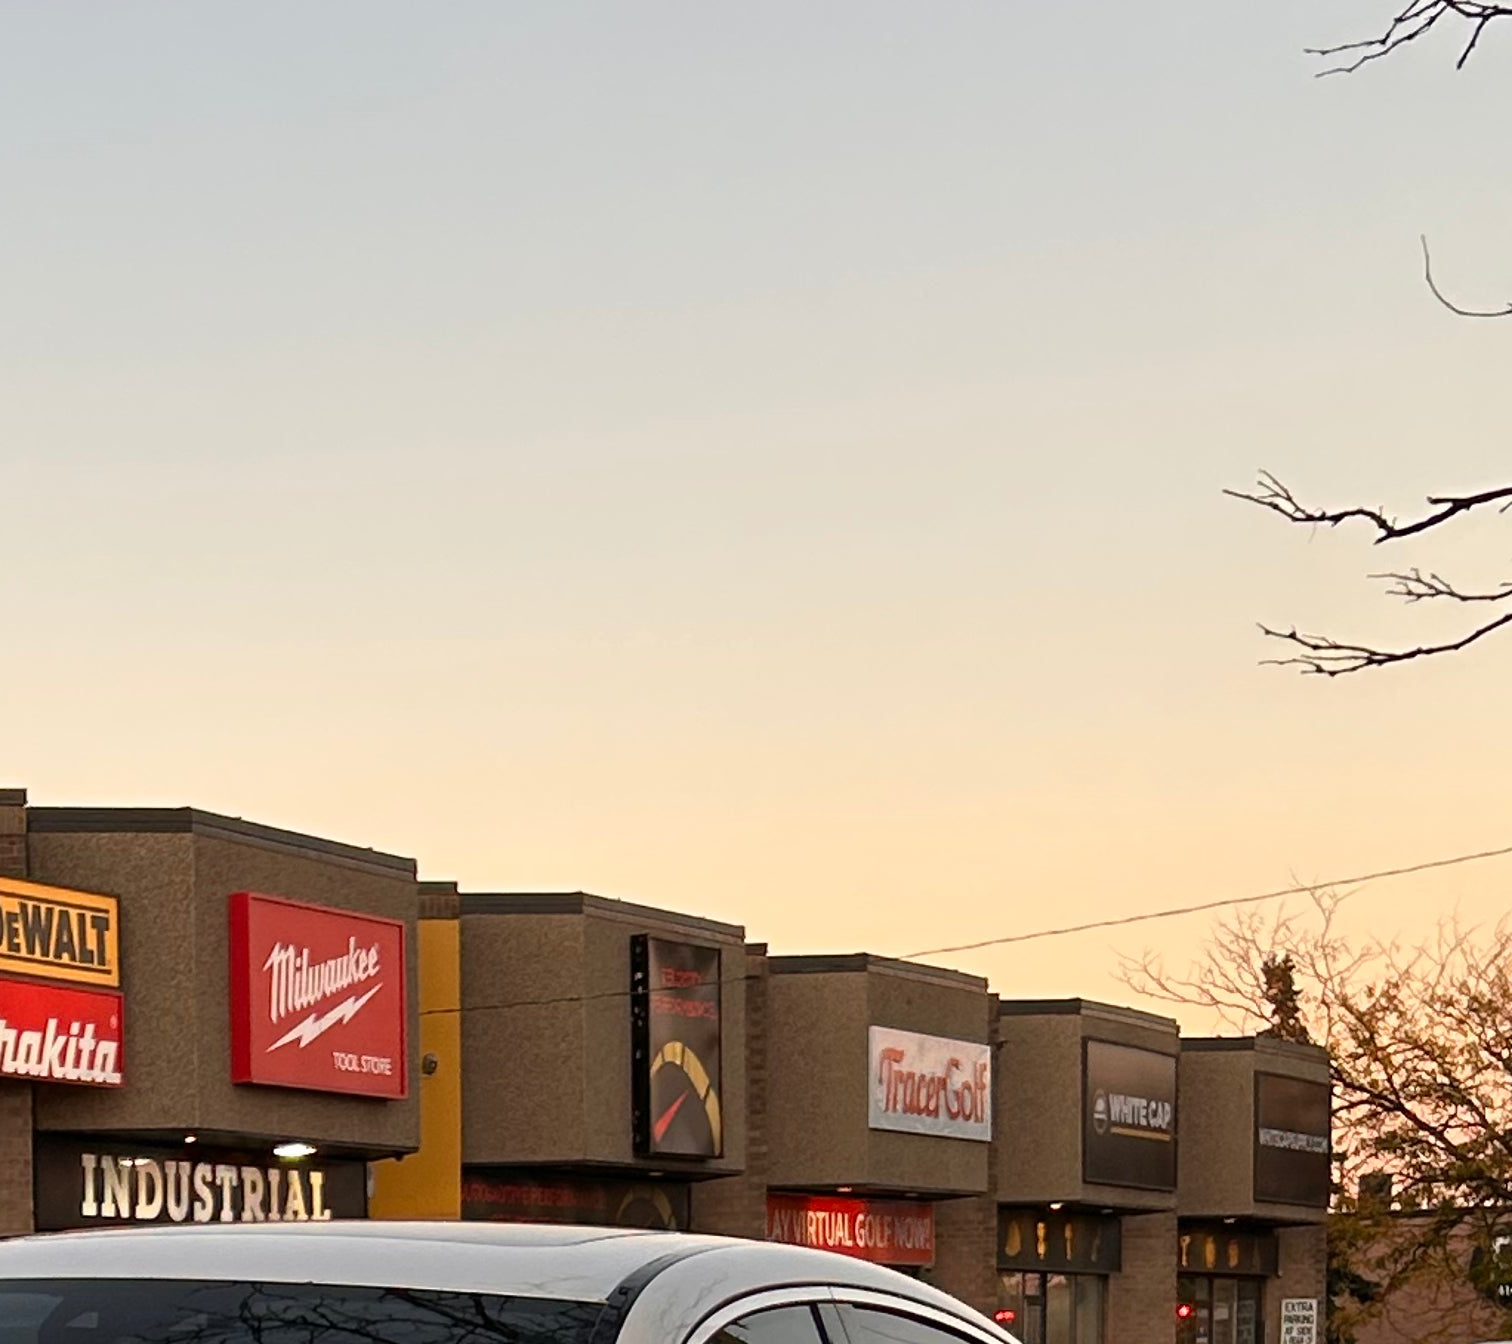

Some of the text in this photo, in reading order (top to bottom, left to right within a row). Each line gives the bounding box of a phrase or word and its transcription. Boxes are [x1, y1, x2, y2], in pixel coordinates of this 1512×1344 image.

[263, 936, 381, 1024] Milwaukee
[333, 1051, 392, 1075] TOOL STORE
[1108, 1093, 1172, 1129] WHITE CAP
[81, 1153, 332, 1222] INDUSTRIAL
[793, 1210, 854, 1247] VIRTUAL
[855, 1213, 892, 1248] GOLF
